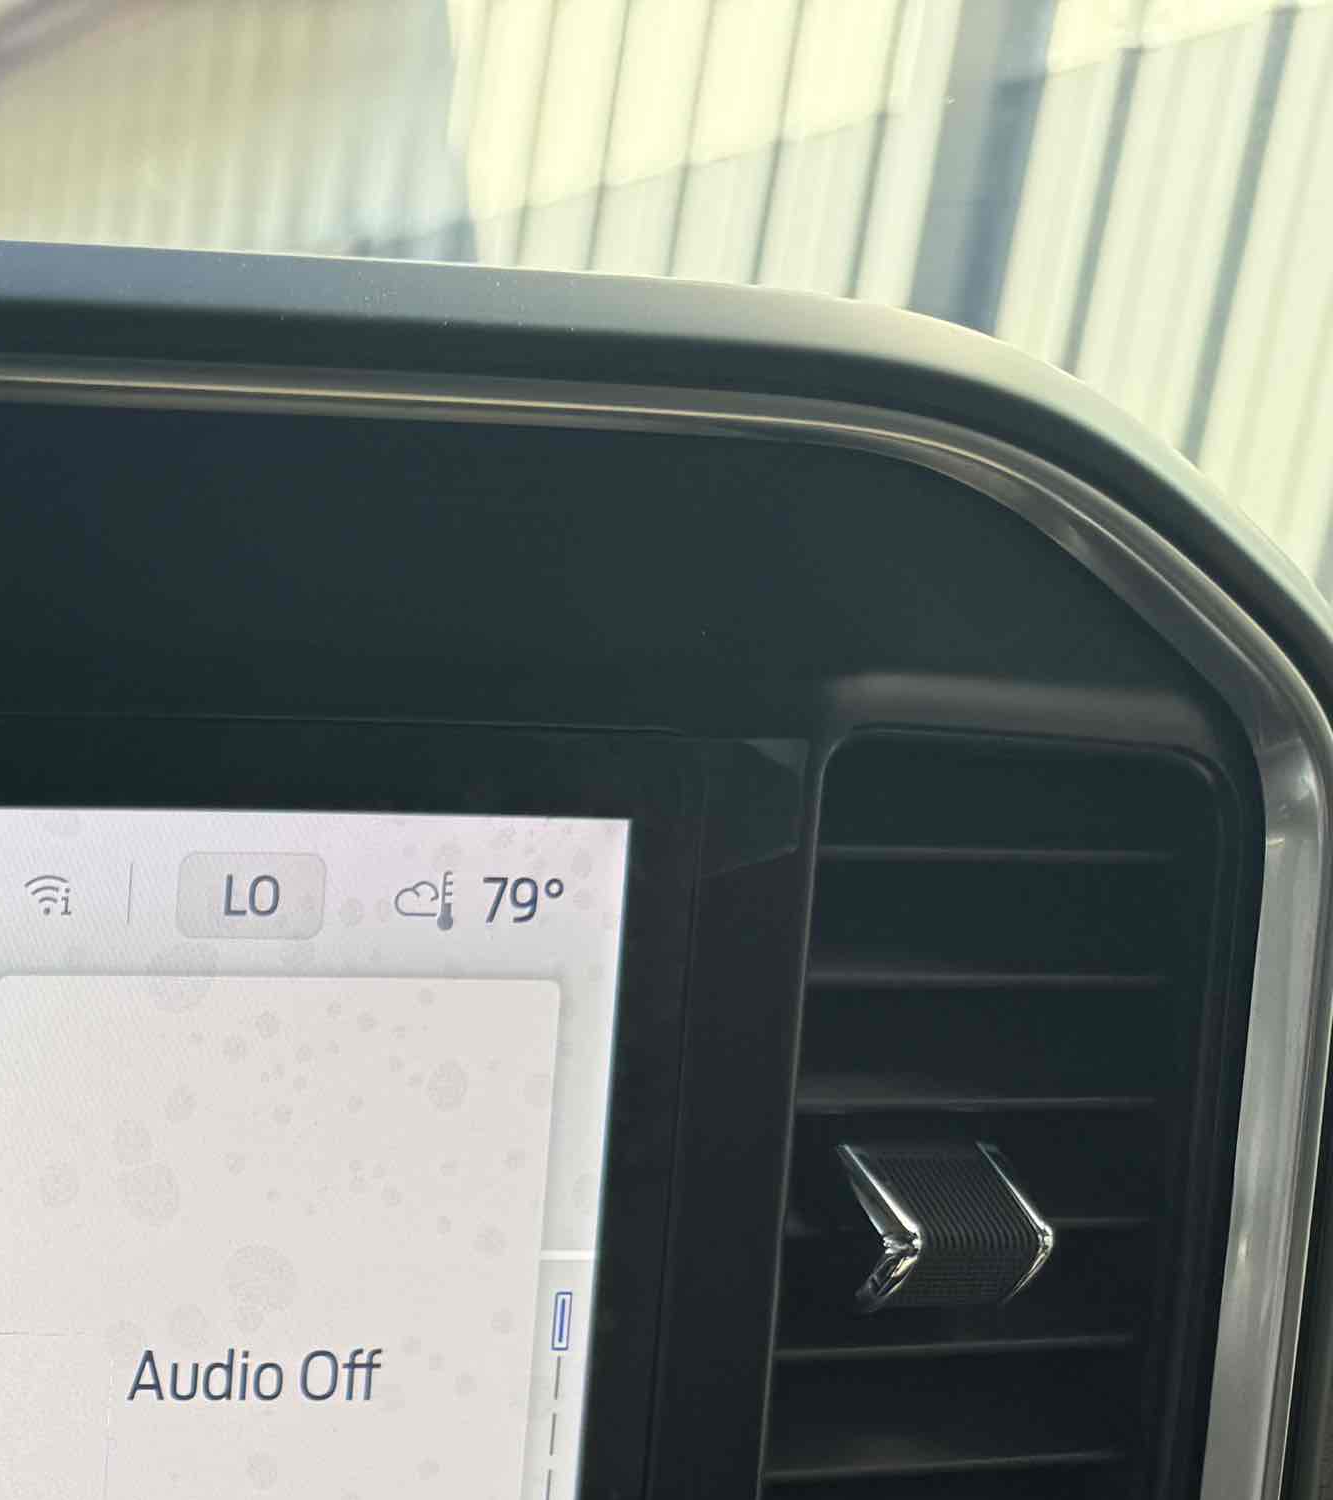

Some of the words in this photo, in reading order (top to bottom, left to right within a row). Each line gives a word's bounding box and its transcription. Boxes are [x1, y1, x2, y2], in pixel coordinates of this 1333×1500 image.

[223, 873, 280, 917] LO
[482, 876, 565, 924] 79°
[126, 1347, 284, 1401] Audio
[299, 1347, 383, 1401] Off
